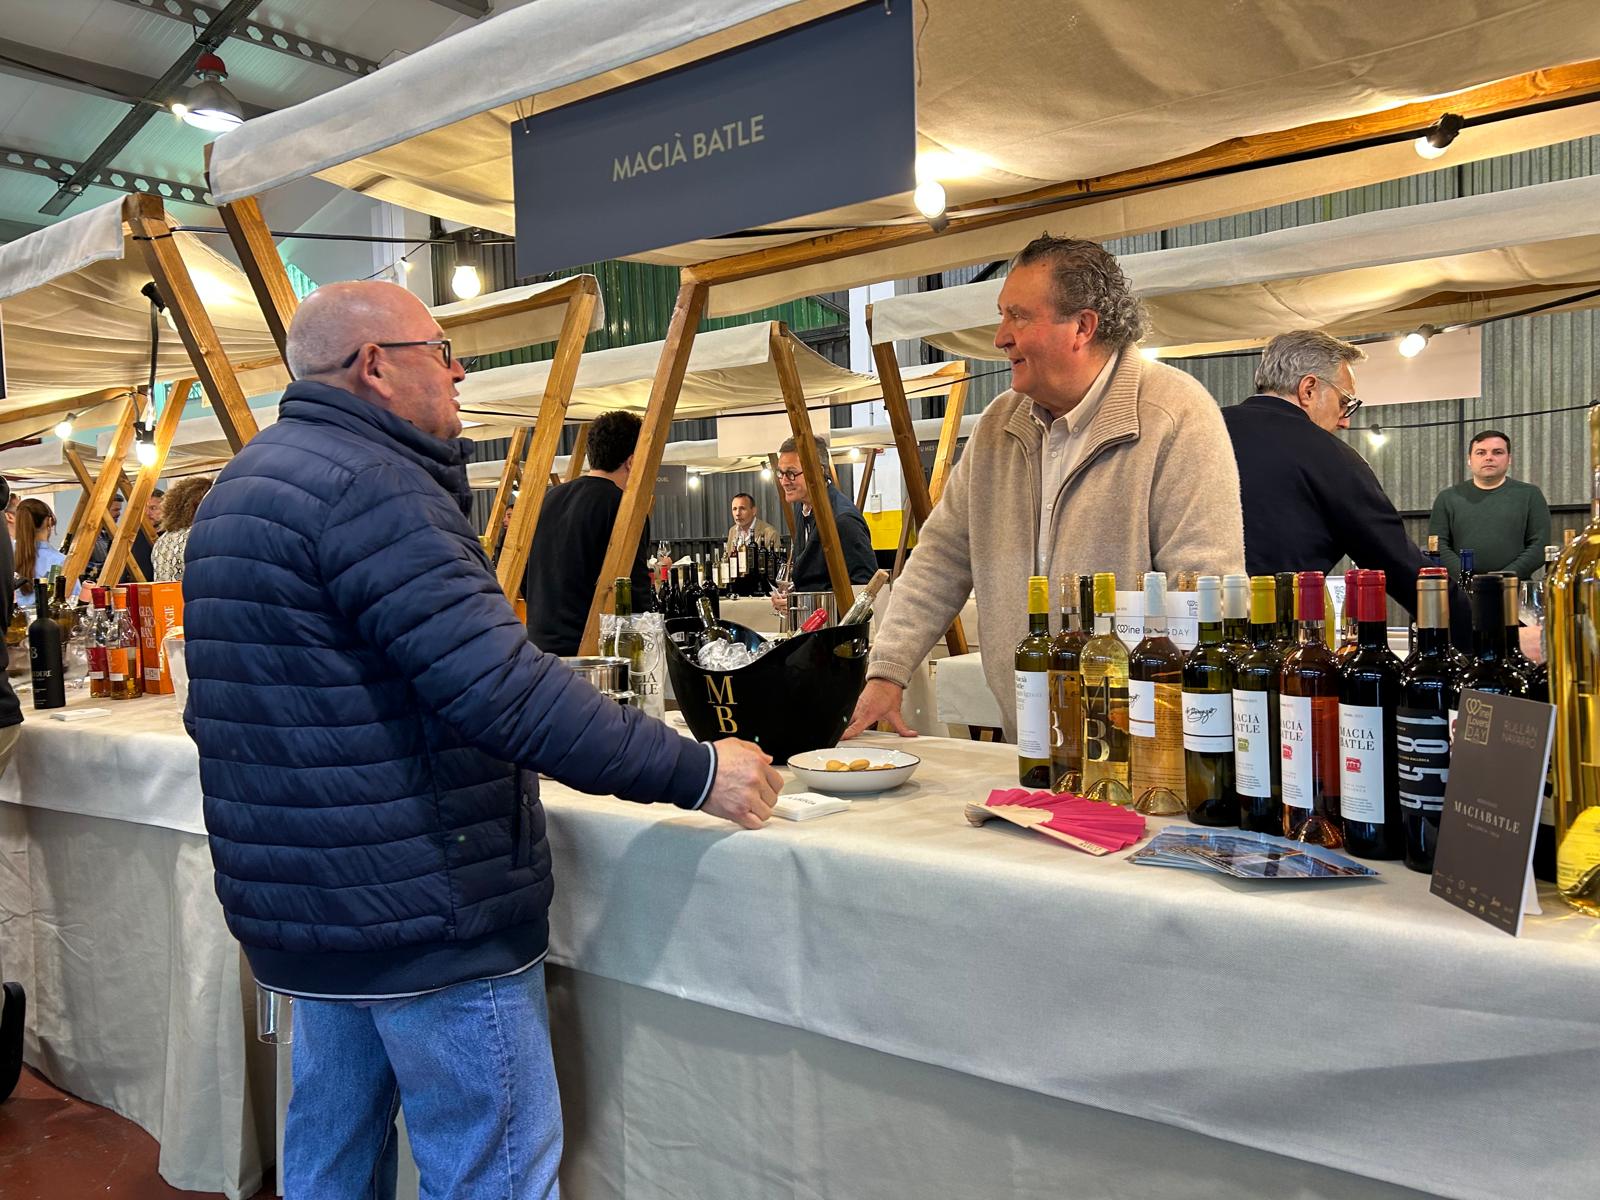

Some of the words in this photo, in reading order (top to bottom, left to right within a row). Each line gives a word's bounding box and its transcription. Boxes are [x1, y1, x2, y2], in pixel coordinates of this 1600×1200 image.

[612, 132, 688, 182] MACIÀ
[693, 114, 765, 160] BATLE
[1172, 628, 1189, 637] DAY
[703, 674, 738, 705] M
[713, 705, 738, 733] B
[1234, 723, 1261, 733] ATLE
[1081, 717, 1110, 762] B
[1281, 730, 1304, 741] ATLE
[1467, 726, 1487, 742] DAY
